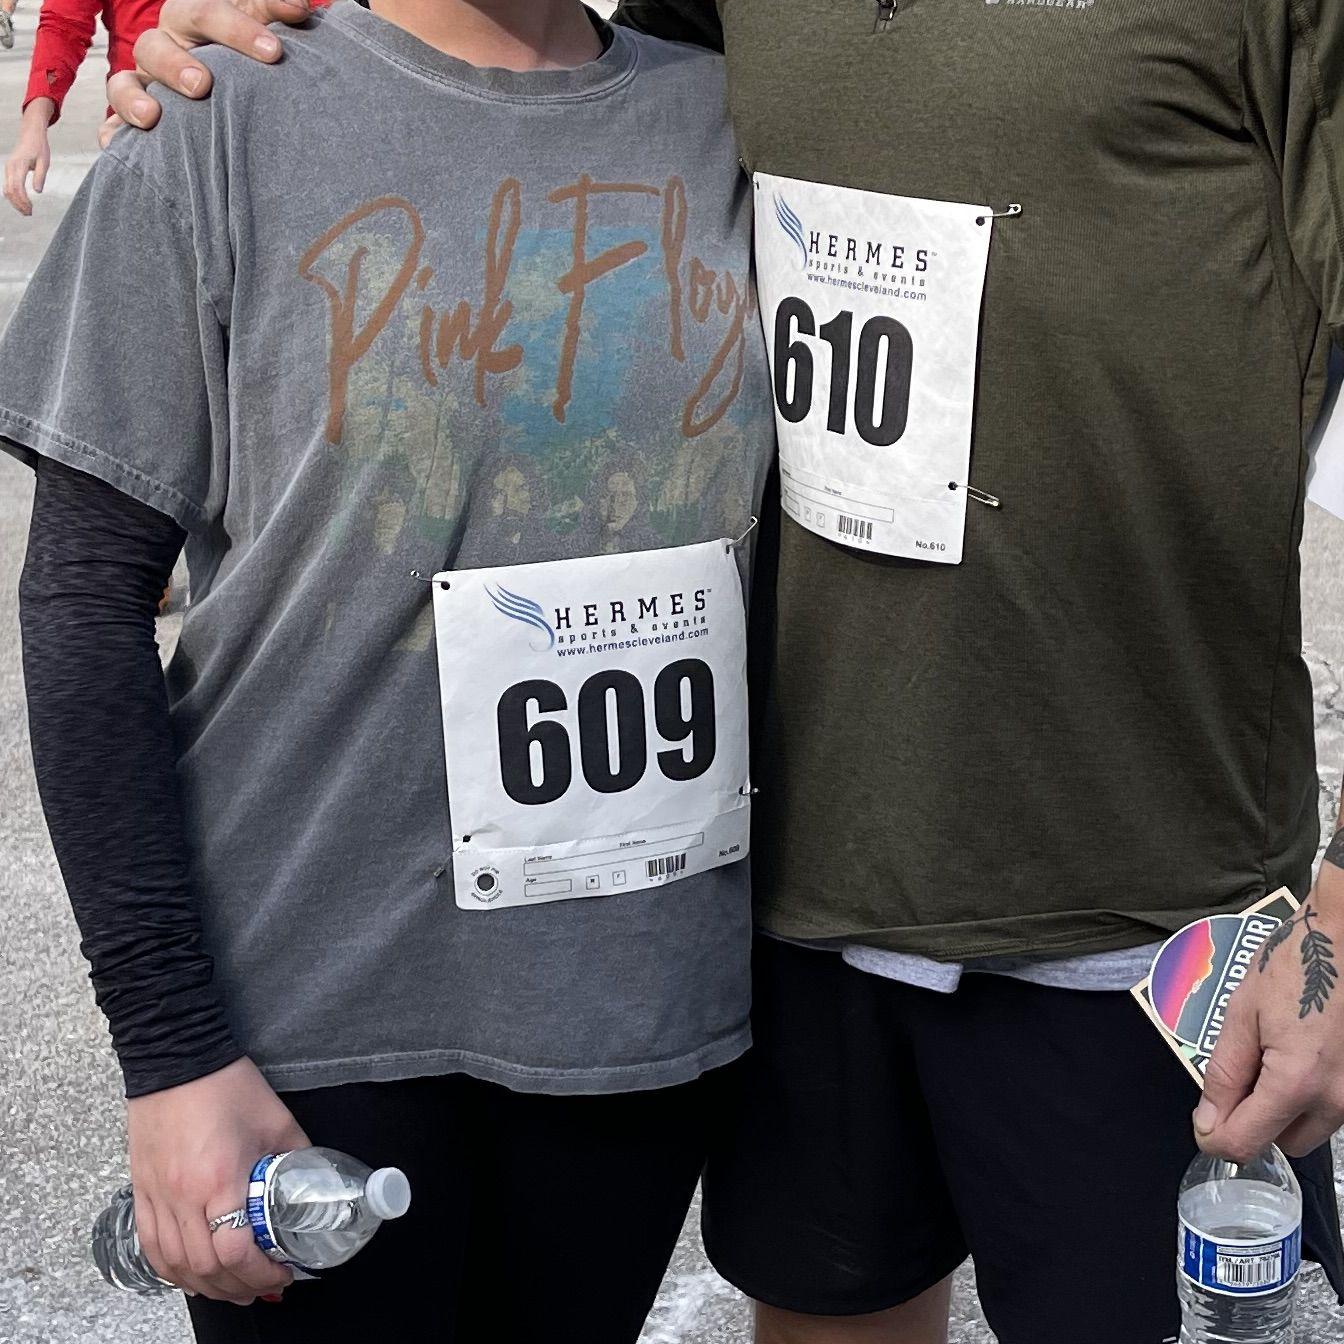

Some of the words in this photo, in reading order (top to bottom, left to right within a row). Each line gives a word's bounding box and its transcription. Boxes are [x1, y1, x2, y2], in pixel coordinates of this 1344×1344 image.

[299, 176, 525, 446] Pink
[808, 258, 849, 275] sports
[872, 270, 926, 288] events
[773, 296, 914, 447] 610
[557, 627, 618, 644] sports
[651, 615, 707, 633] events
[497, 658, 717, 806] 609
